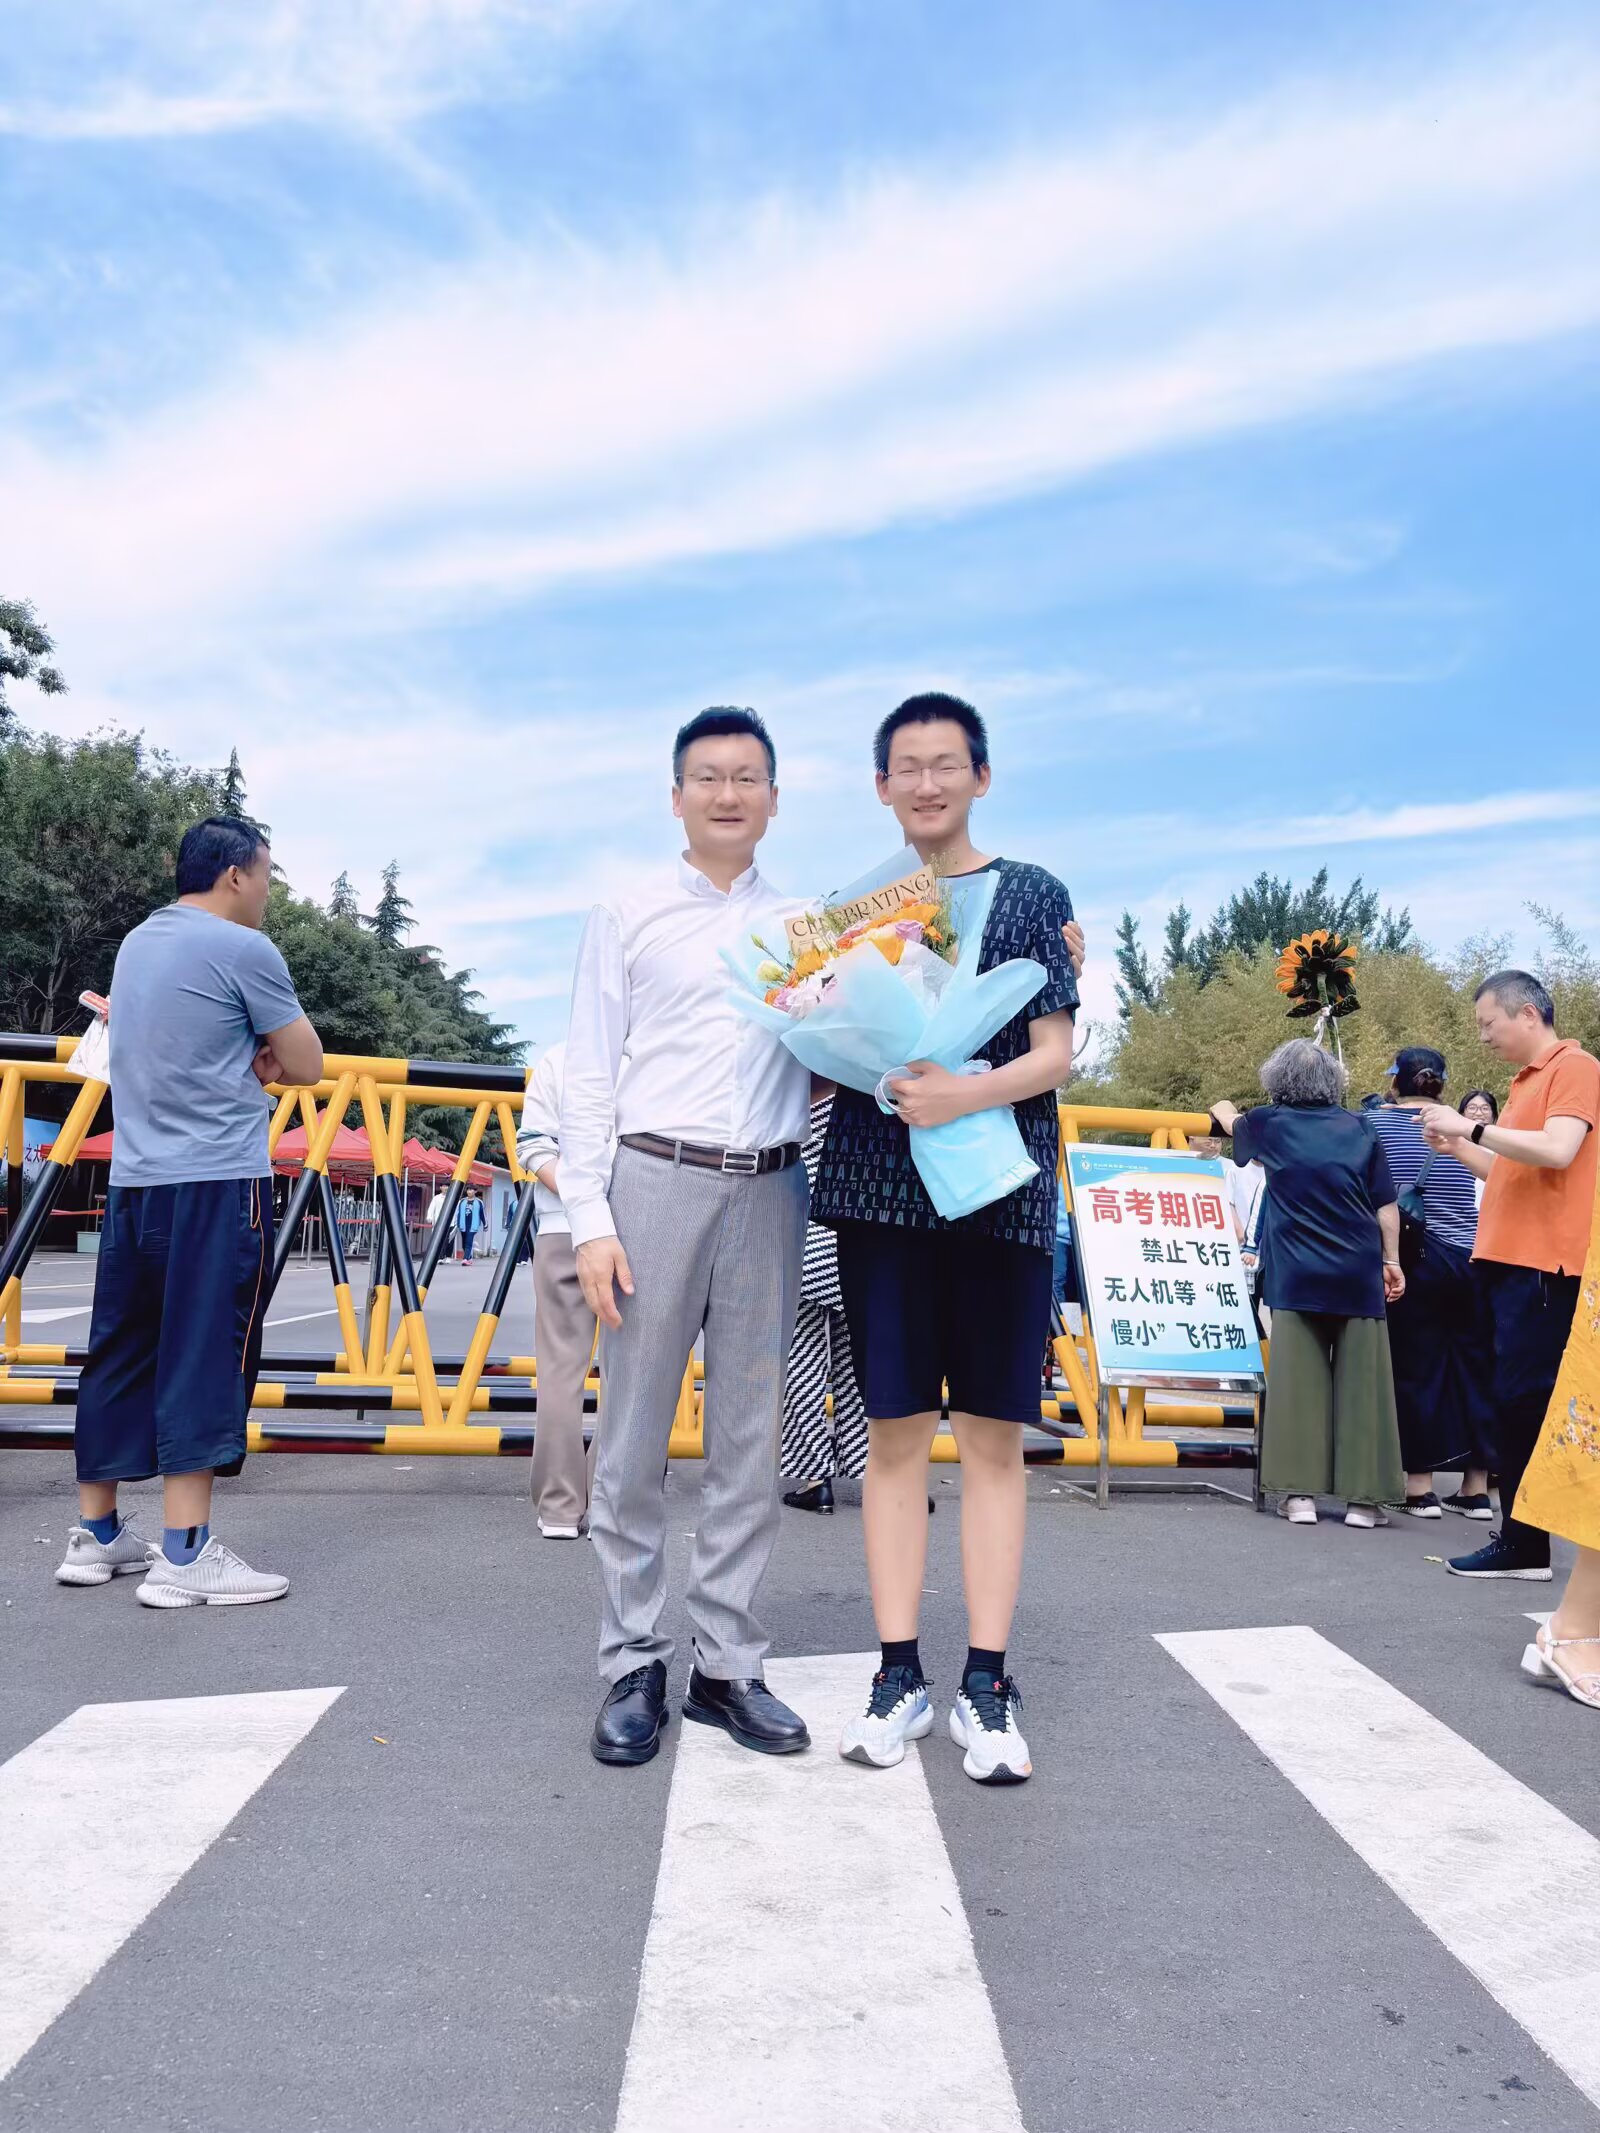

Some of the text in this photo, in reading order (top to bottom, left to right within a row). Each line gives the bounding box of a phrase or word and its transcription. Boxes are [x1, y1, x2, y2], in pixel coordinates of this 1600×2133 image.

[1088, 1186, 1226, 1231] 高考期间
[1140, 1237, 1232, 1267] 禁止飞行
[1103, 1276, 1240, 1308] 无人机等“低
[1110, 1318, 1248, 1351] 慢小”飞行物
